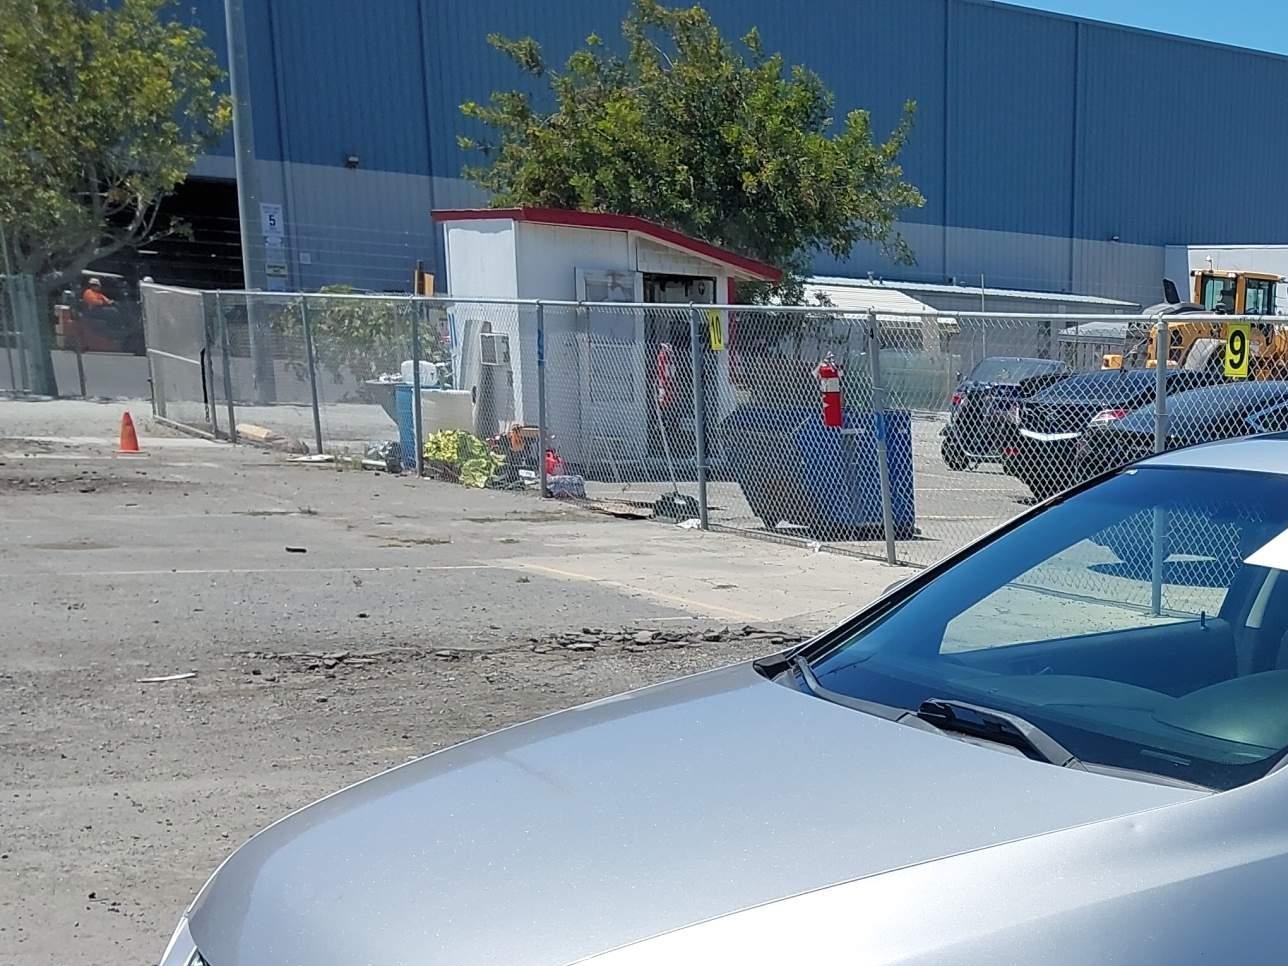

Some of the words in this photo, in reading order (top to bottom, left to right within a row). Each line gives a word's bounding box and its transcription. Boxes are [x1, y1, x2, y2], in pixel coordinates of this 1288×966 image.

[268, 214, 276, 226] 5
[711, 315, 722, 345] 10
[1229, 329, 1246, 370] 9
